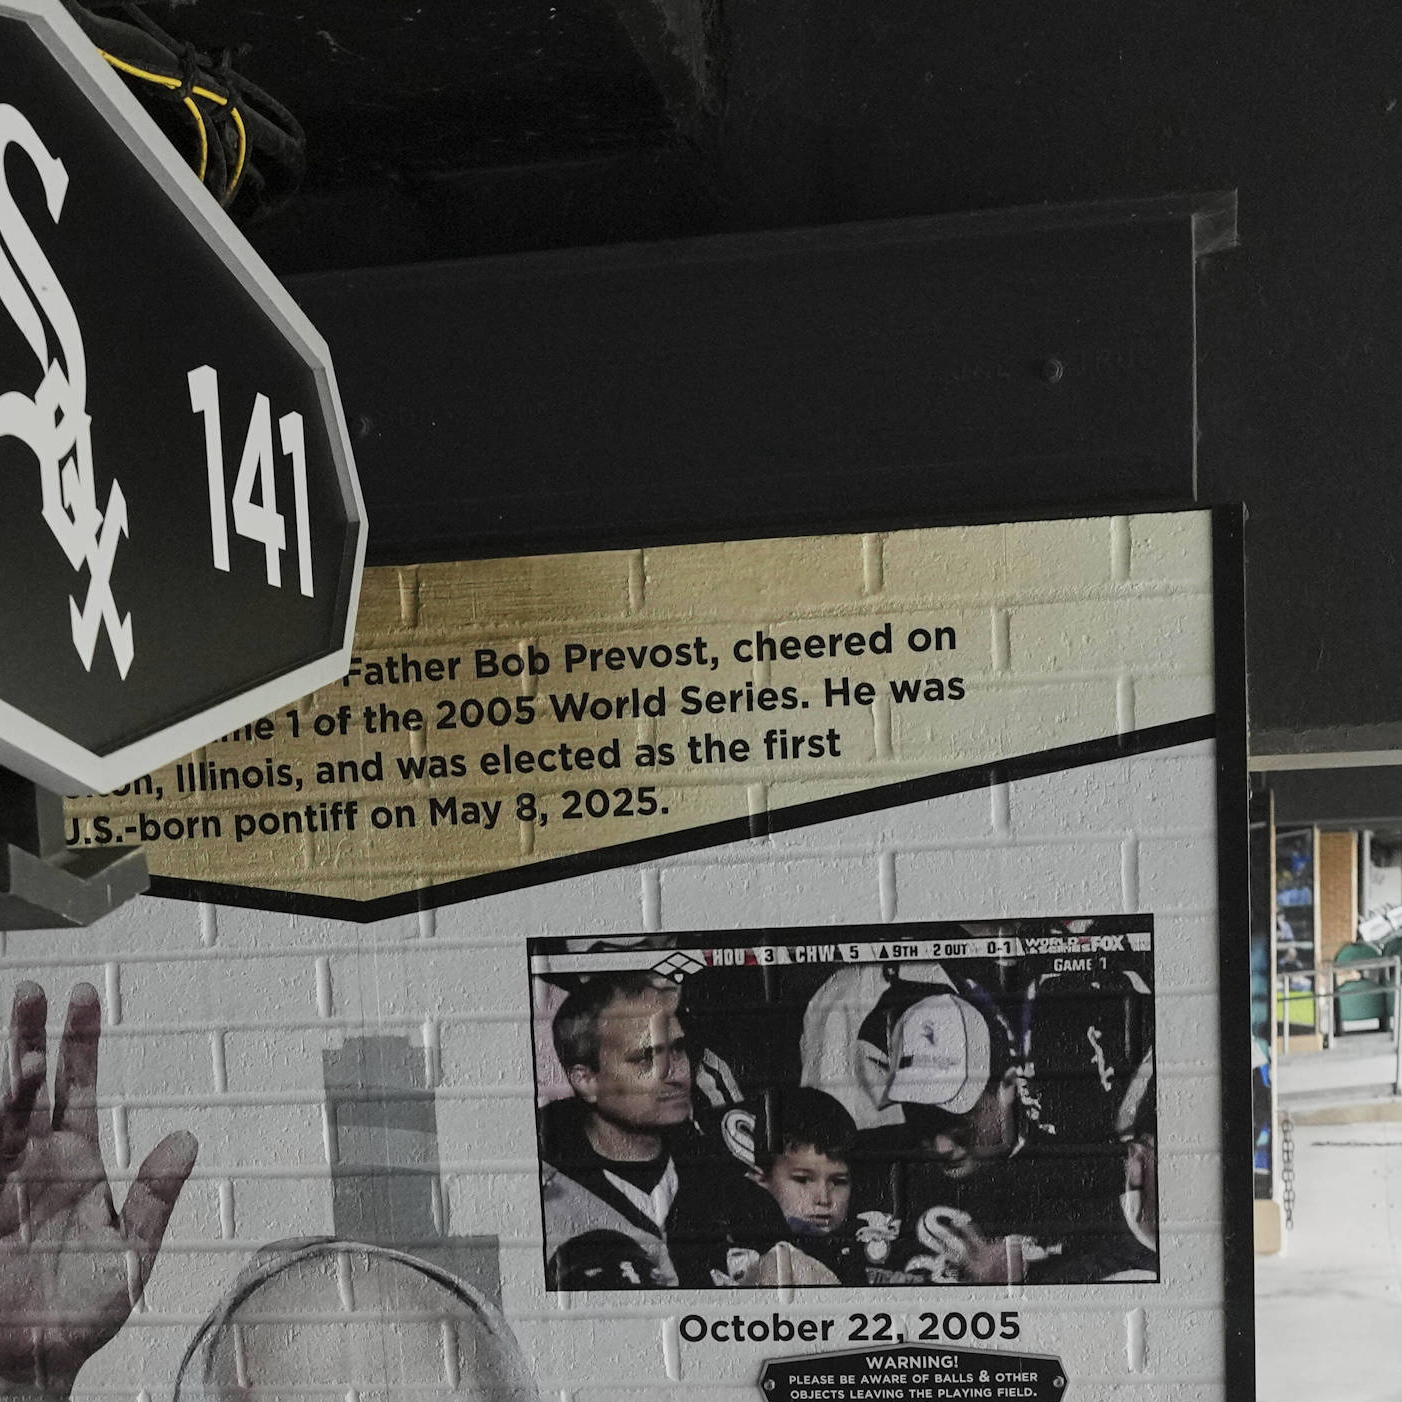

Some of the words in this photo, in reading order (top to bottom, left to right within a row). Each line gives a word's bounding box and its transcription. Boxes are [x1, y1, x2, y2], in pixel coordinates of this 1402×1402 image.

[187, 364, 315, 598] 141
[342, 652, 462, 688] Father
[474, 644, 550, 679] Bob
[564, 636, 719, 673] Prevost,
[733, 622, 893, 663] cheered
[907, 625, 957, 652] on
[286, 709, 300, 739] 1
[313, 704, 352, 737] of
[363, 703, 424, 734] the
[435, 695, 536, 730] 2005
[549, 686, 666, 723] World
[680, 681, 809, 715] Series.
[824, 676, 876, 707] He
[889, 676, 965, 704] was
[175, 757, 304, 792] Illinois,
[315, 751, 384, 784] and
[396, 754, 467, 781] was
[479, 738, 621, 775] elected
[634, 742, 675, 768] as
[687, 733, 750, 764] the
[763, 728, 841, 761] first
[234, 801, 359, 842] pontiff
[370, 800, 416, 829] on
[429, 796, 502, 830] May
[515, 792, 548, 827] 8,
[561, 786, 670, 819] 2025.
[712, 948, 746, 967] HOU
[763, 946, 775, 963] 3
[795, 944, 836, 963] CHW
[849, 944, 860, 960] 5
[932, 944, 942, 957] 2
[944, 942, 968, 956] OUT
[1090, 934, 1125, 953] FOX
[1053, 958, 1093, 972] GAME
[1099, 957, 1107, 970] 1
[679, 1313, 834, 1342] October
[848, 1313, 904, 1344] 22,
[918, 1311, 1021, 1340] 2005
[865, 1355, 959, 1370] WARNING!
[789, 1375, 835, 1386] PLEASE
[839, 1375, 856, 1385] BE
[860, 1374, 908, 1385] AWARE
[912, 1373, 930, 1384] OF
[934, 1373, 974, 1383] BALLS
[978, 1370, 991, 1383] &
[995, 1372, 1039, 1383] OTHER
[790, 1389, 846, 1400] OBJECTS
[849, 1389, 904, 1399] LEAVING
[908, 1388, 934, 1399] THE
[937, 1388, 993, 1399] PLAYING
[997, 1387, 1039, 1398] FIELD.
